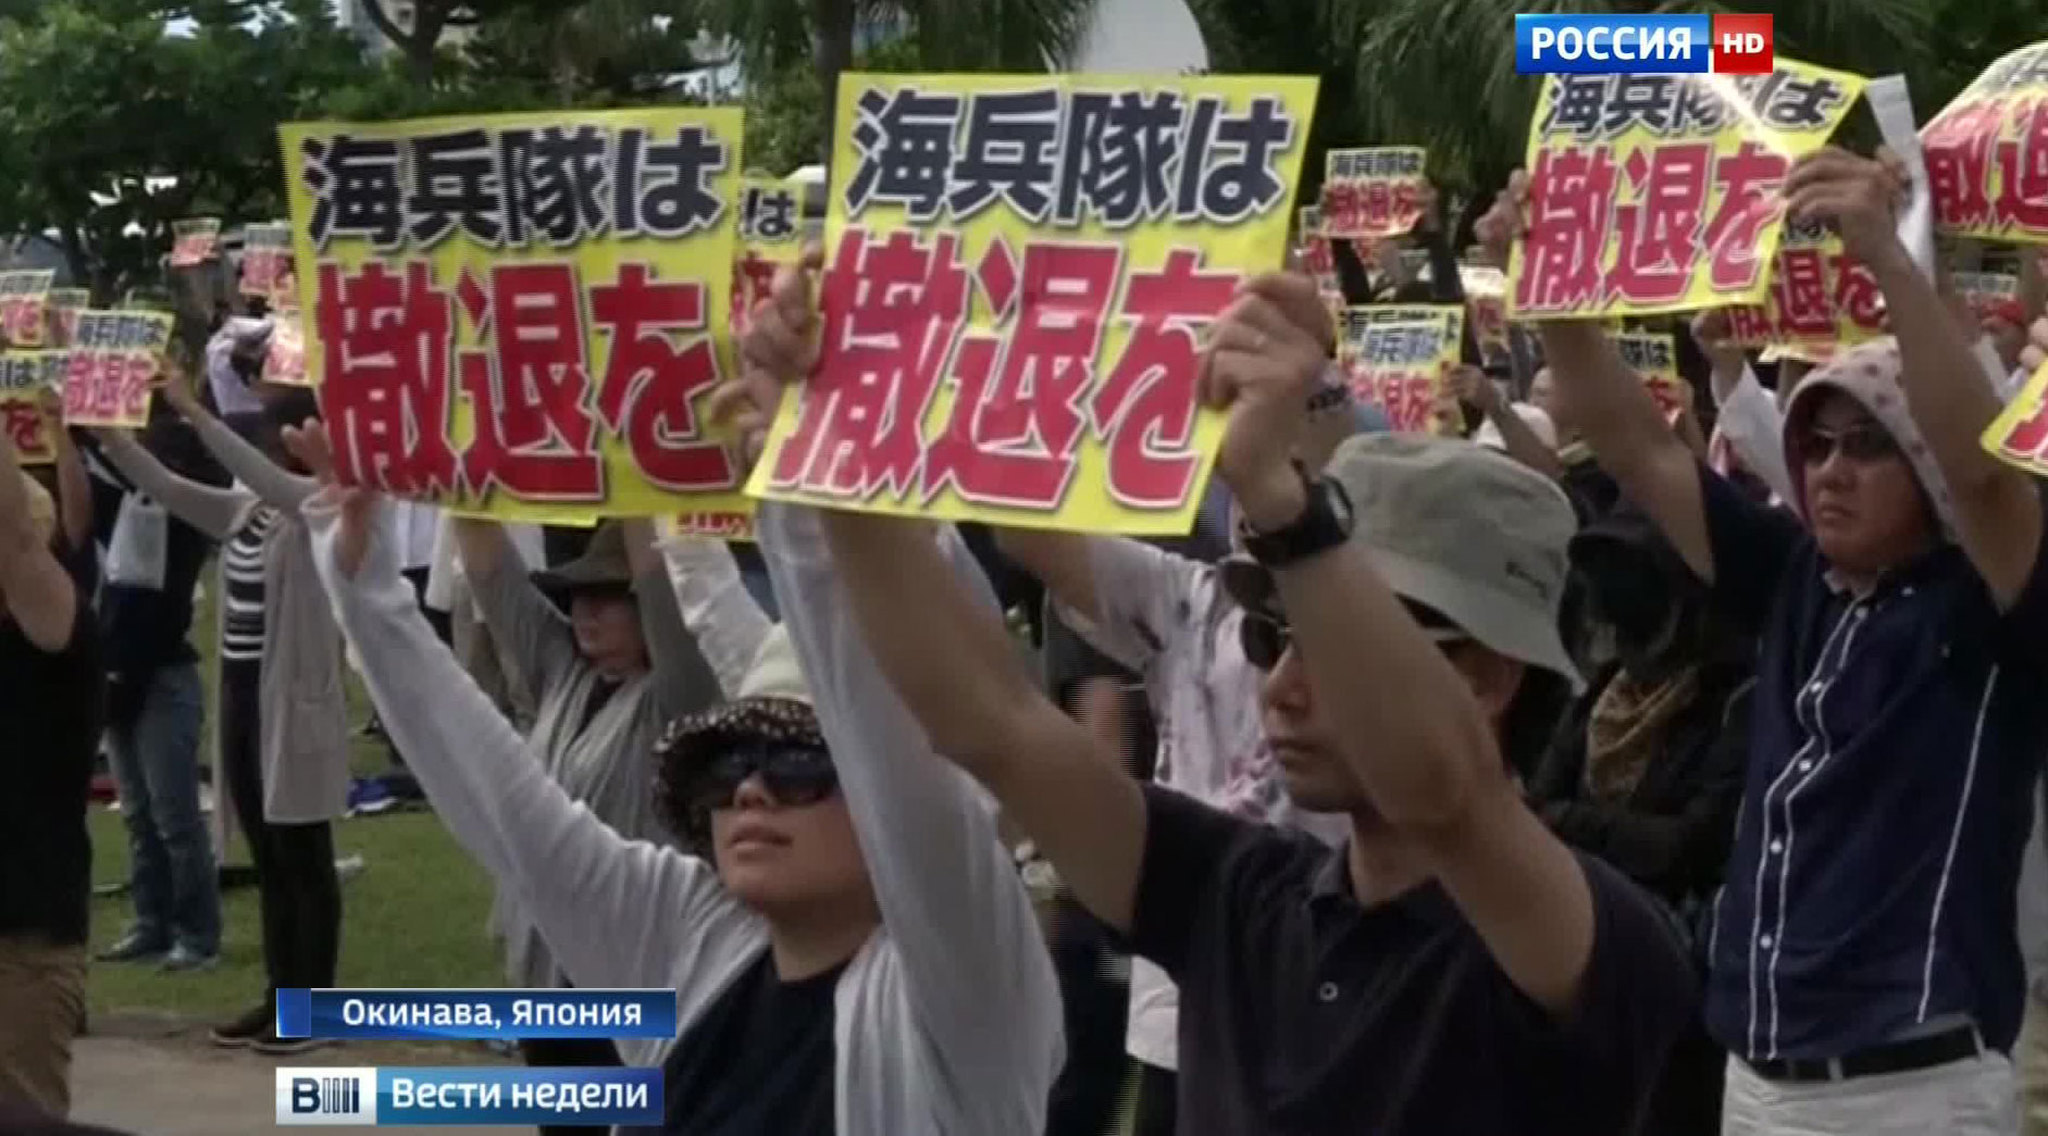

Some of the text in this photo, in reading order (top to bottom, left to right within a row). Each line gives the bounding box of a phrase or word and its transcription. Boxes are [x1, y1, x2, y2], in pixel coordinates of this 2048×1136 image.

[299, 124, 730, 252] 海兵隊は
[742, 187, 797, 240] は
[844, 88, 1294, 228] 海兵隊は
[1512, 140, 1793, 312] 撤退を
[314, 256, 735, 502] 撤退を
[768, 224, 1242, 508] 撤退を
